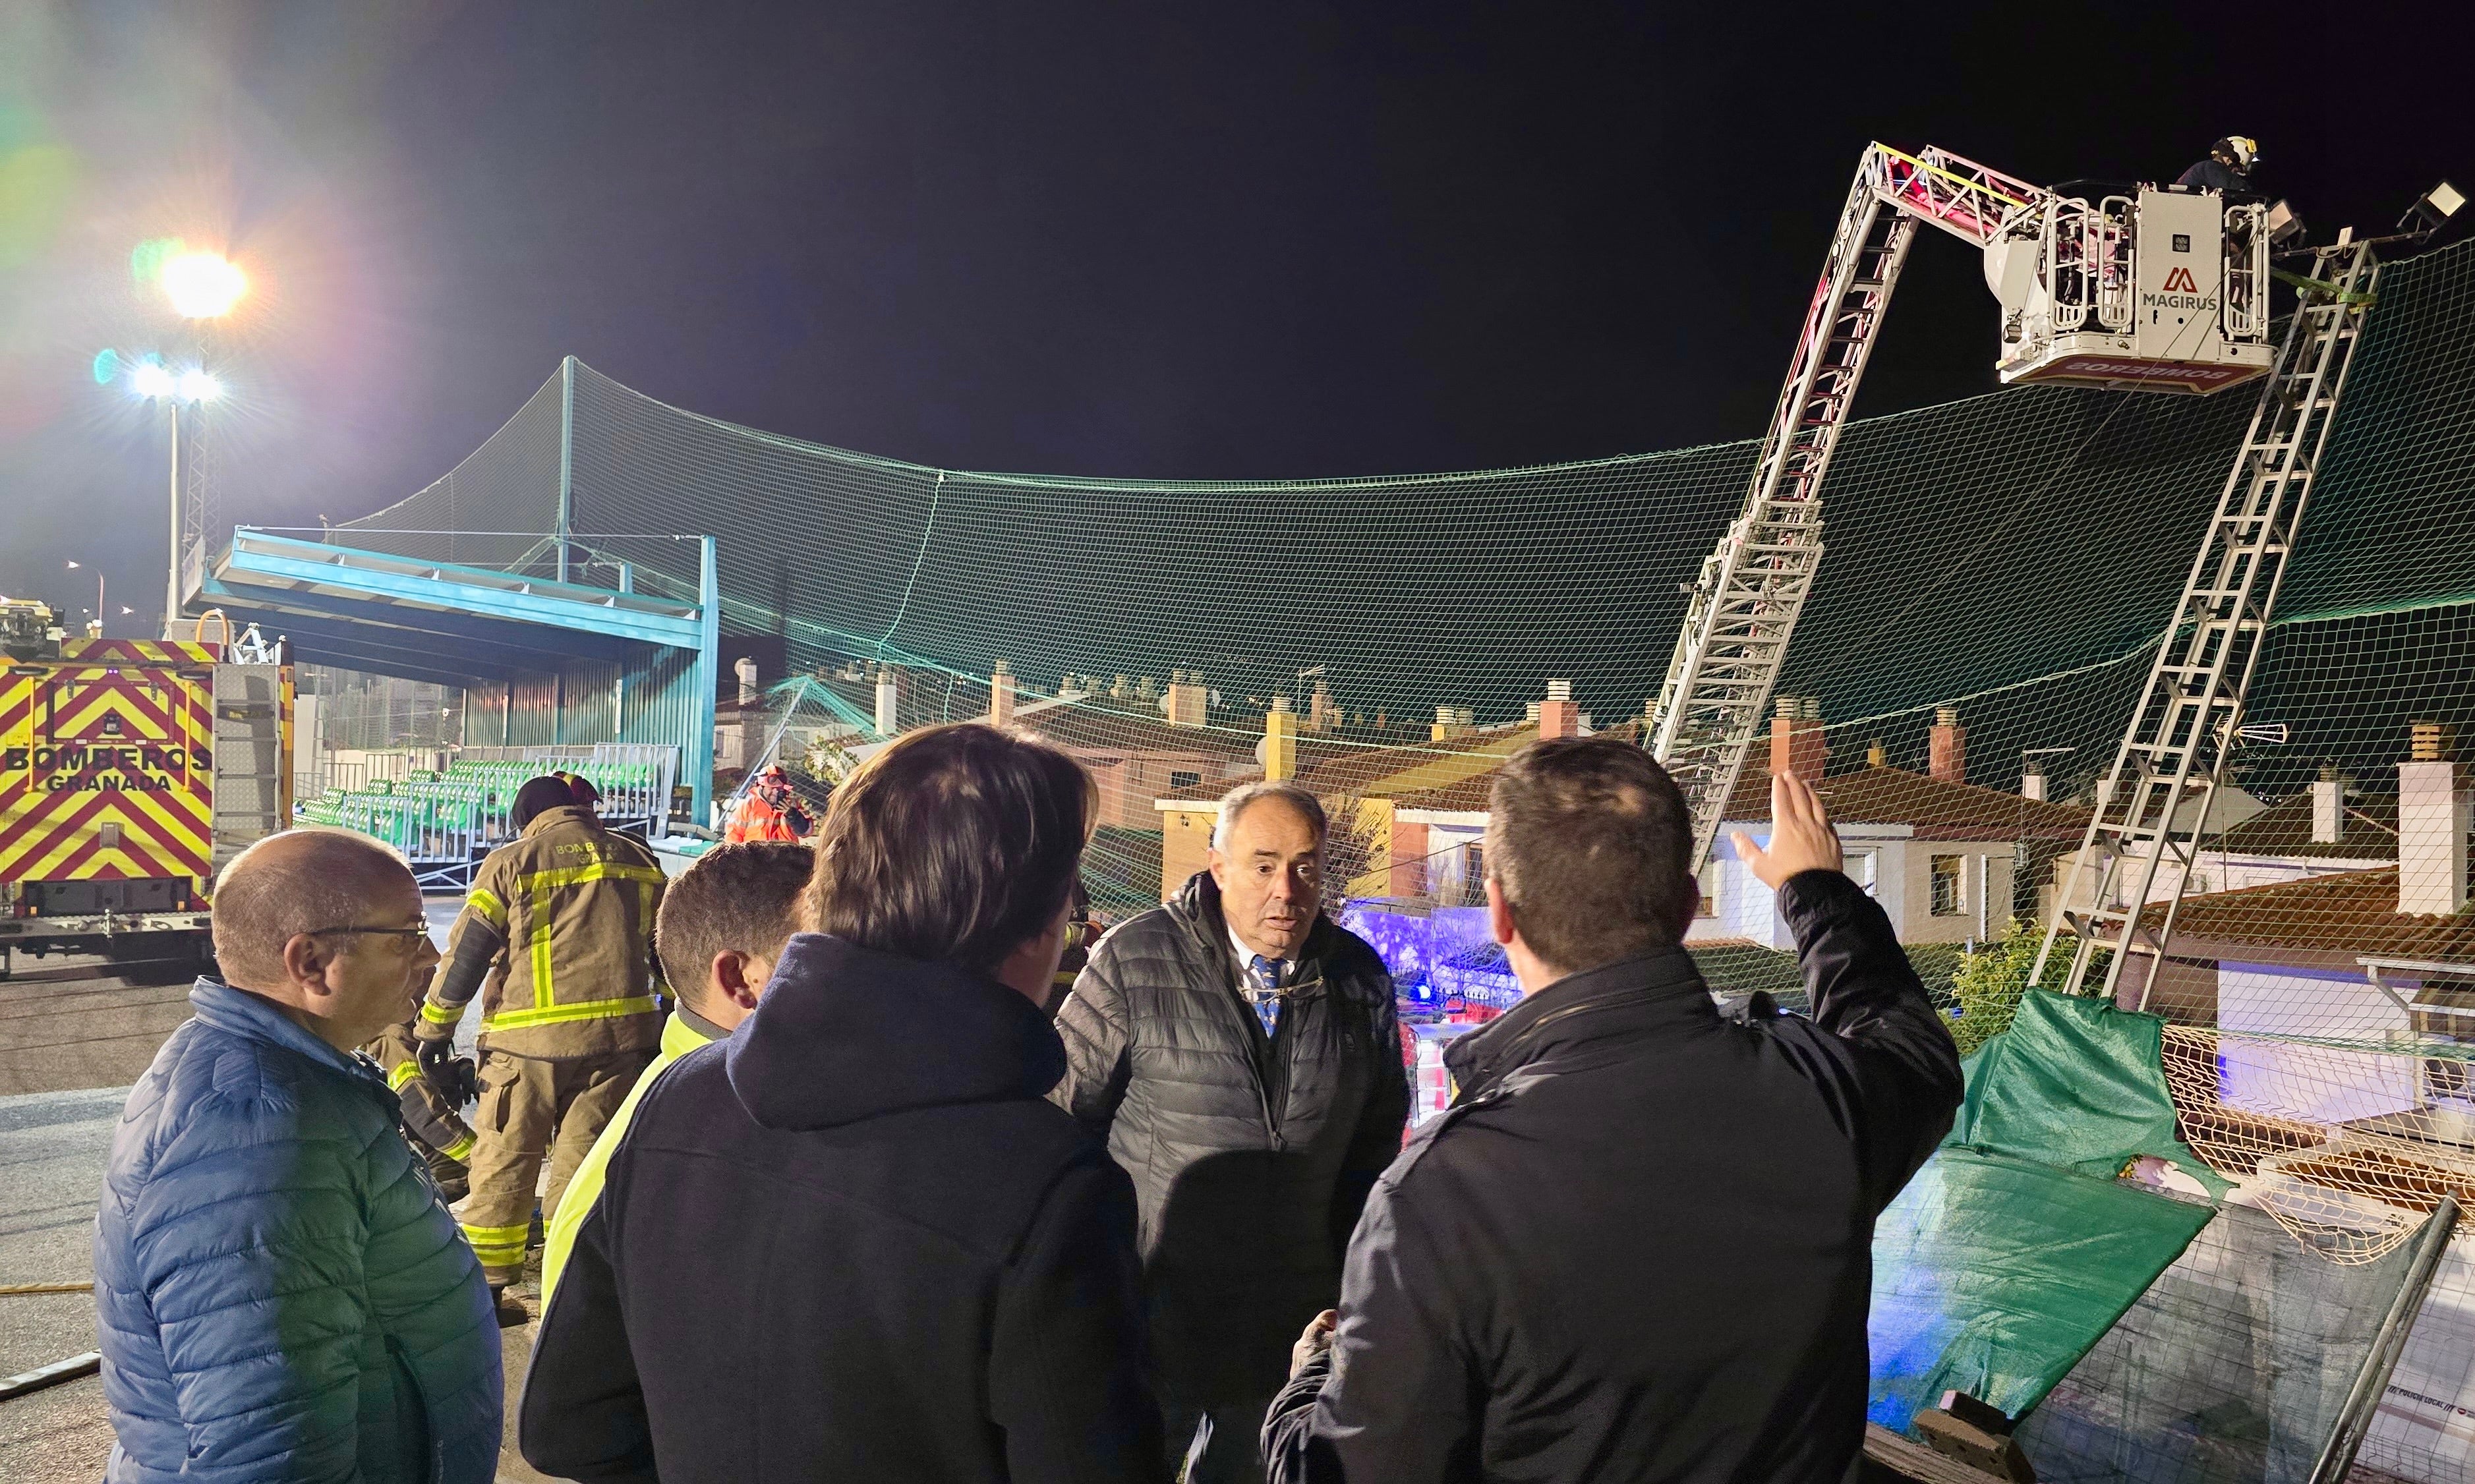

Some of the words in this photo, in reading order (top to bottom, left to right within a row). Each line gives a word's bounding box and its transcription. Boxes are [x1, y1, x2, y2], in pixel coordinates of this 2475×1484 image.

[2143, 293, 2217, 311] MAGIRUS
[6, 747, 212, 770] BOMBEROS
[47, 775, 171, 791] GRANADA
[2424, 1396, 2443, 1408] LOCAL
